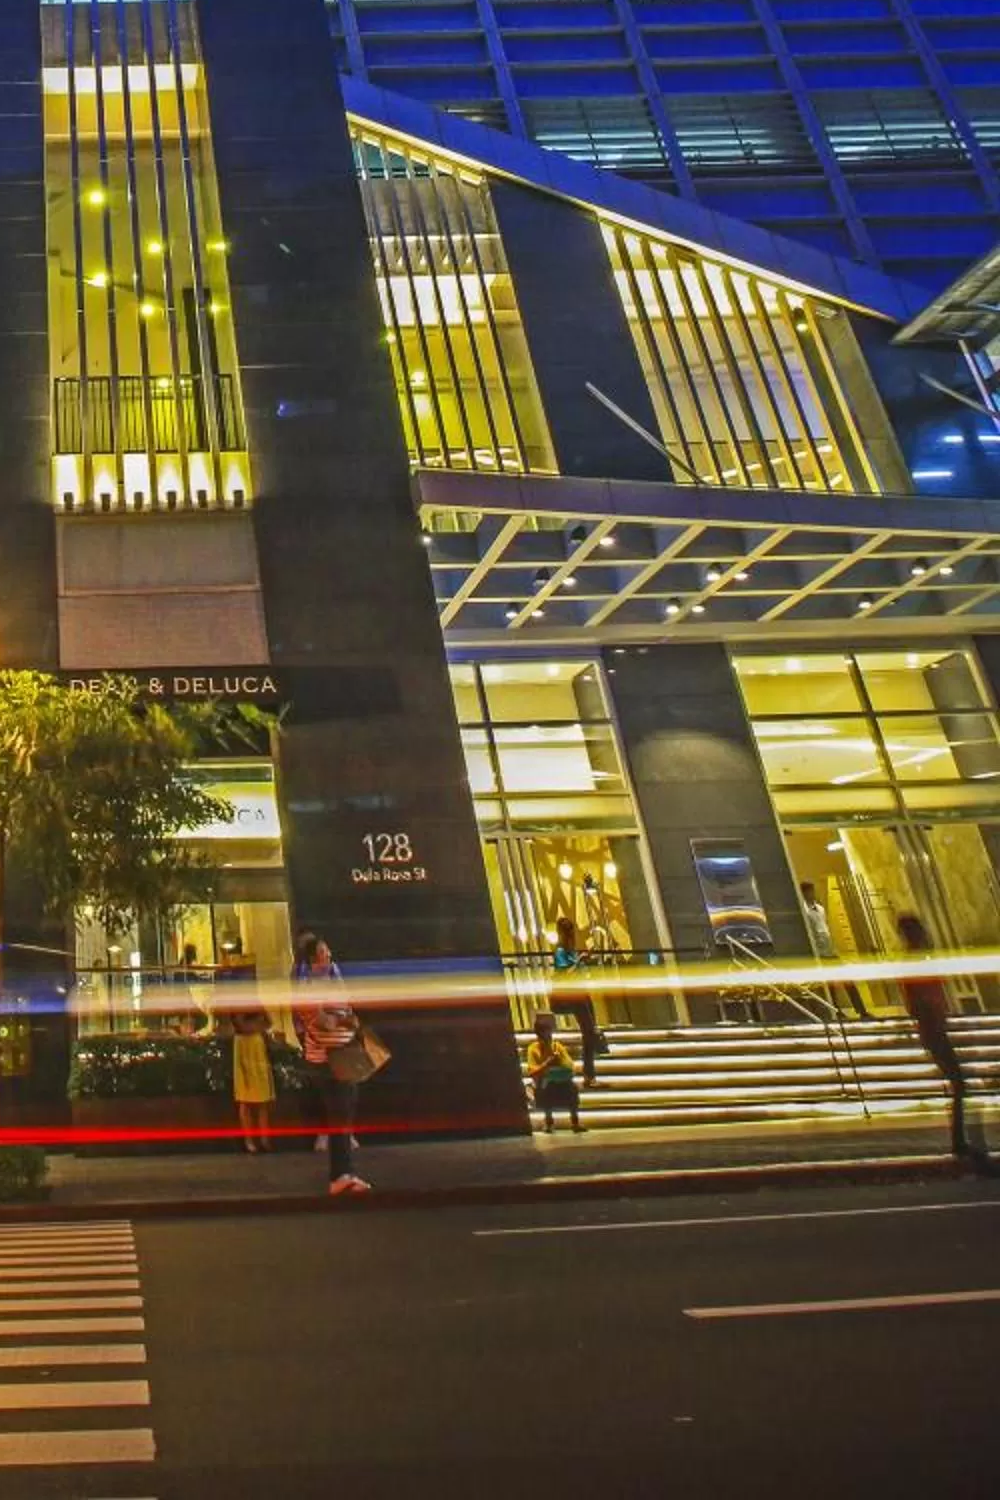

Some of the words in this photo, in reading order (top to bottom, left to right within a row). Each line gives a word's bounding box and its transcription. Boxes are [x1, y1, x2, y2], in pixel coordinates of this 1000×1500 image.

[149, 677, 164, 694] &
[173, 676, 277, 693] DELUCA
[362, 832, 412, 863] 128
